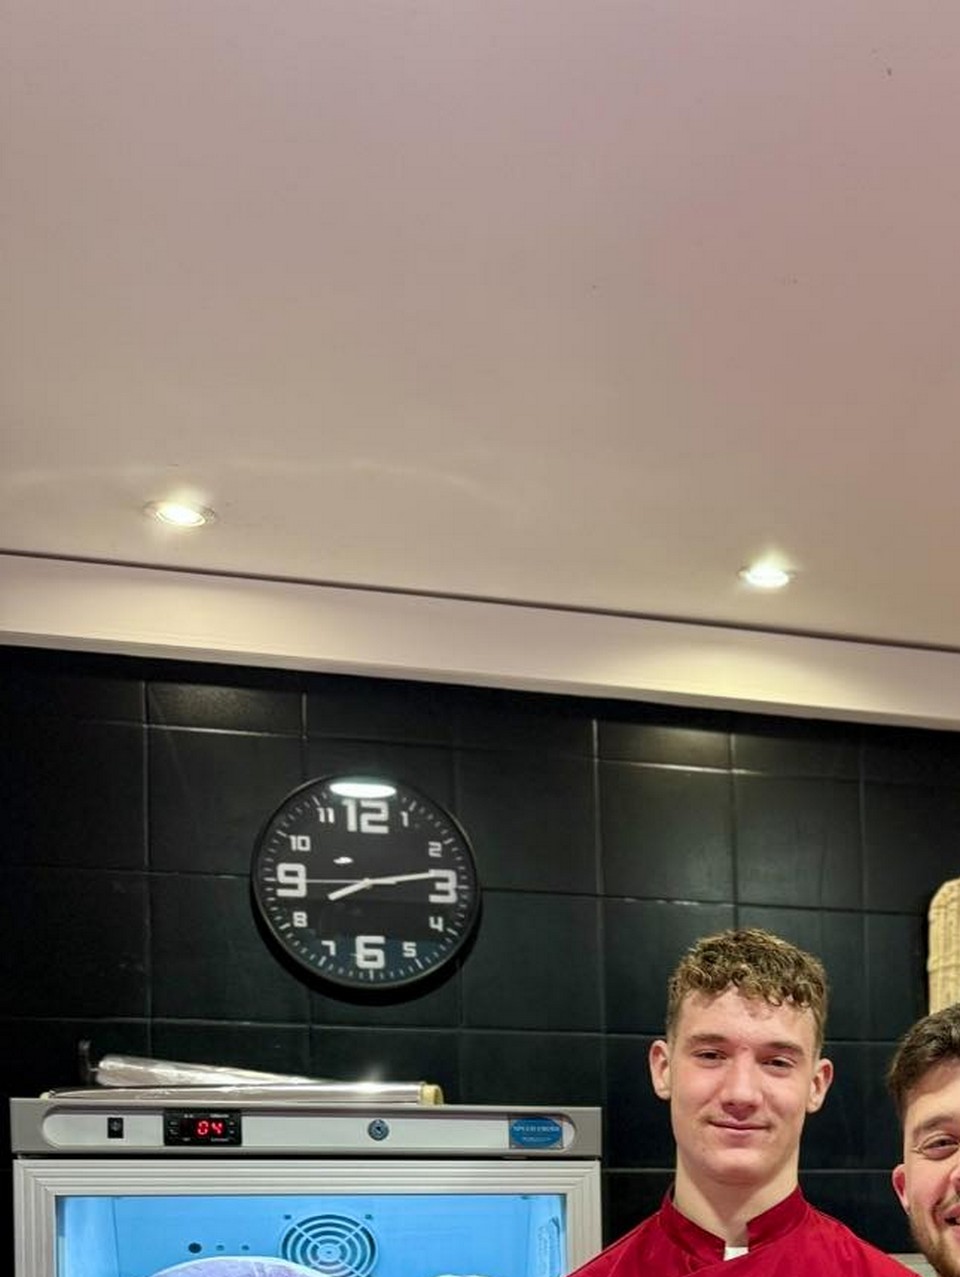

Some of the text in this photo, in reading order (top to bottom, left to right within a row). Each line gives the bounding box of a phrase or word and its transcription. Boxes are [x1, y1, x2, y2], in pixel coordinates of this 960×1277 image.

[317, 807, 335, 823] 11
[341, 800, 389, 834] 12
[401, 812, 409, 827] 1
[289, 835, 311, 851] 10
[429, 842, 442, 857] 2
[276, 863, 307, 897] 9
[429, 869, 457, 903] 3
[293, 912, 307, 927] 8
[429, 916, 443, 931] 4
[321, 940, 336, 955] 7
[355, 935, 385, 969] 6
[402, 941, 417, 958] 5
